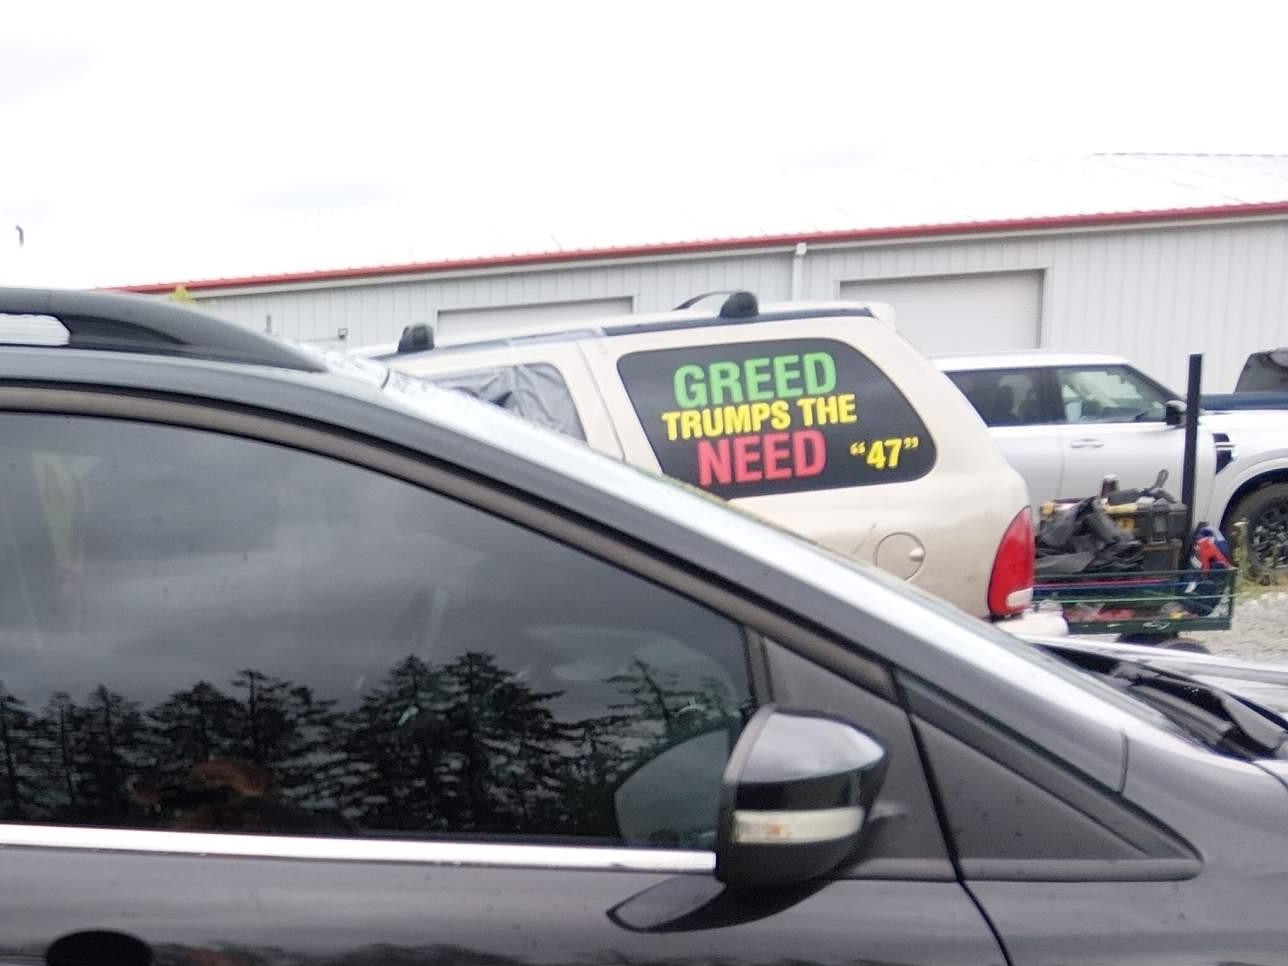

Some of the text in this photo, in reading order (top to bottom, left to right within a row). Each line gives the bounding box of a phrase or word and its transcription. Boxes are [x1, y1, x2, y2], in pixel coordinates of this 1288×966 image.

[673, 352, 837, 408] GREED
[663, 393, 857, 440] TRUMPS THE
[697, 429, 827, 487] NEED
